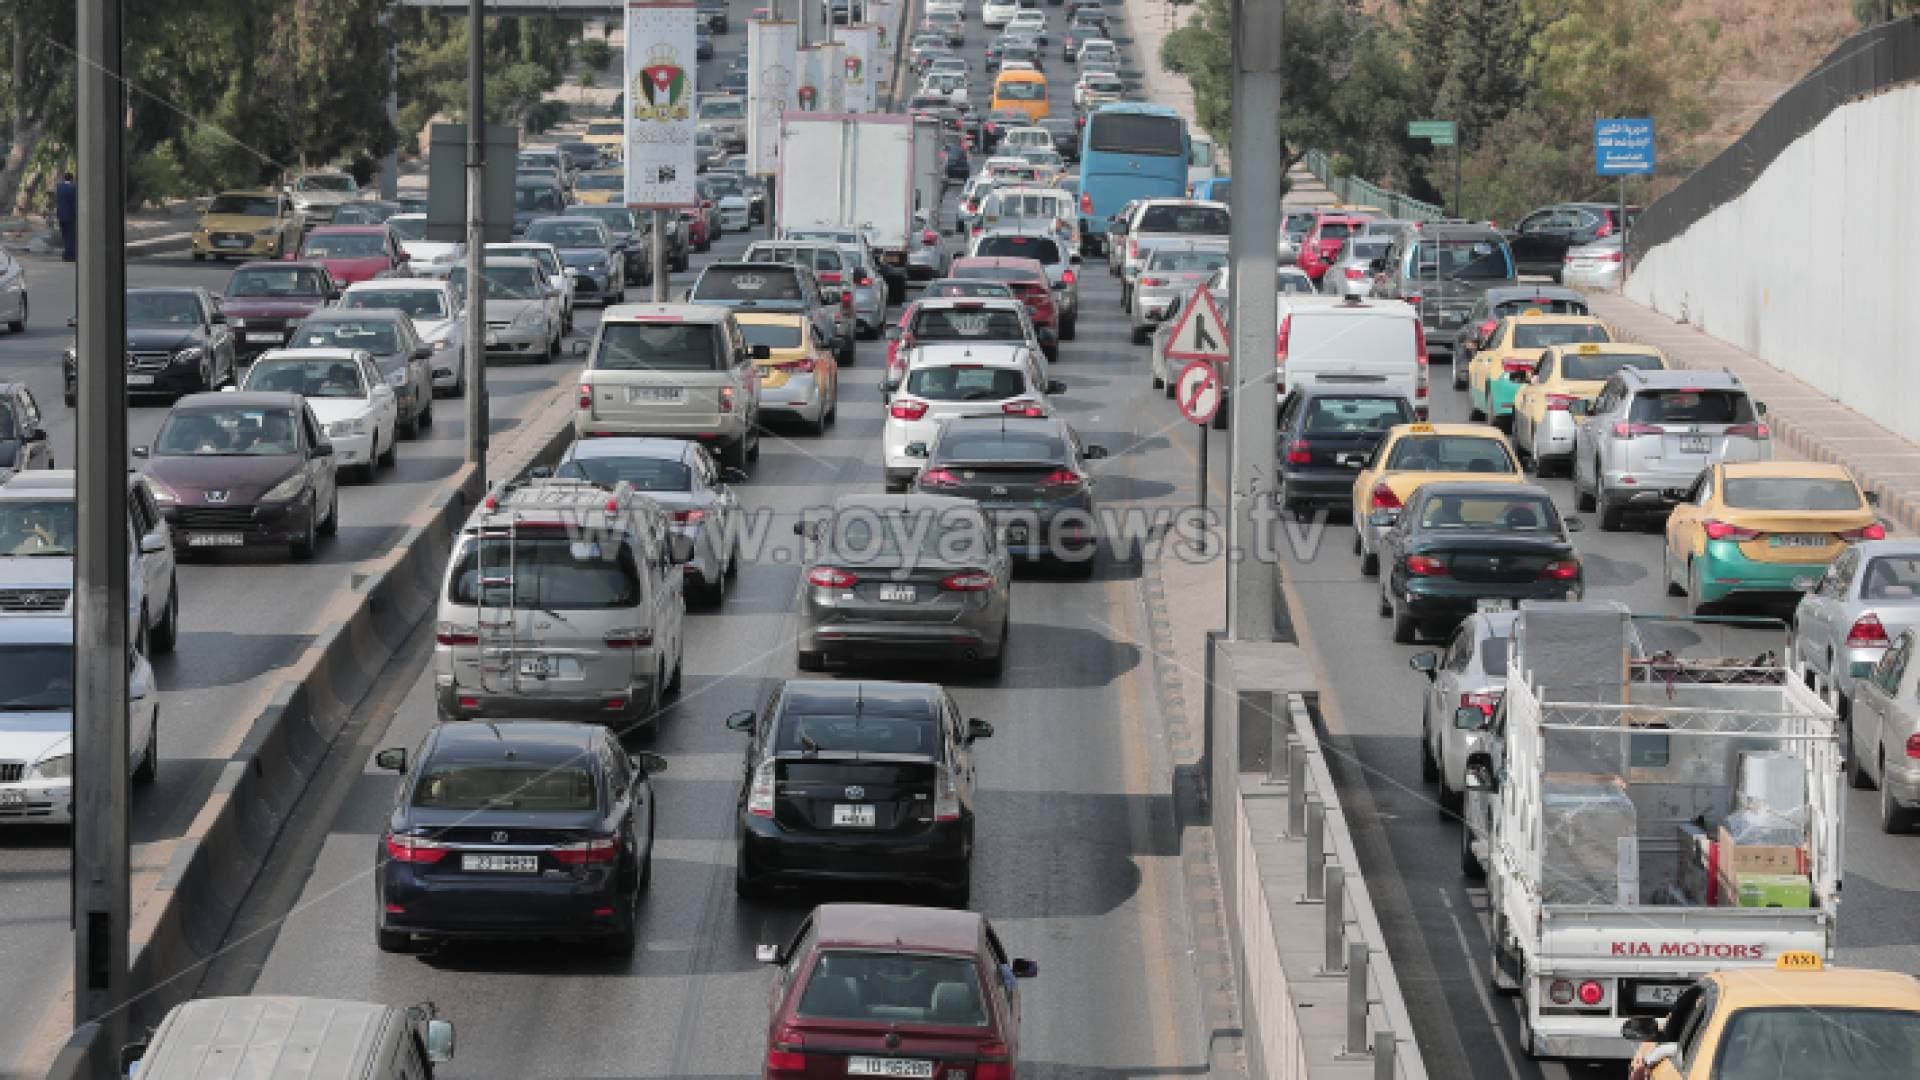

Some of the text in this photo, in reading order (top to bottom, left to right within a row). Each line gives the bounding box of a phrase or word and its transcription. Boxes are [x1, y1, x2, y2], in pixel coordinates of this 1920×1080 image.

[1611, 941, 1764, 959] KIA MOTORS
[1783, 954, 1816, 966] TAXI
